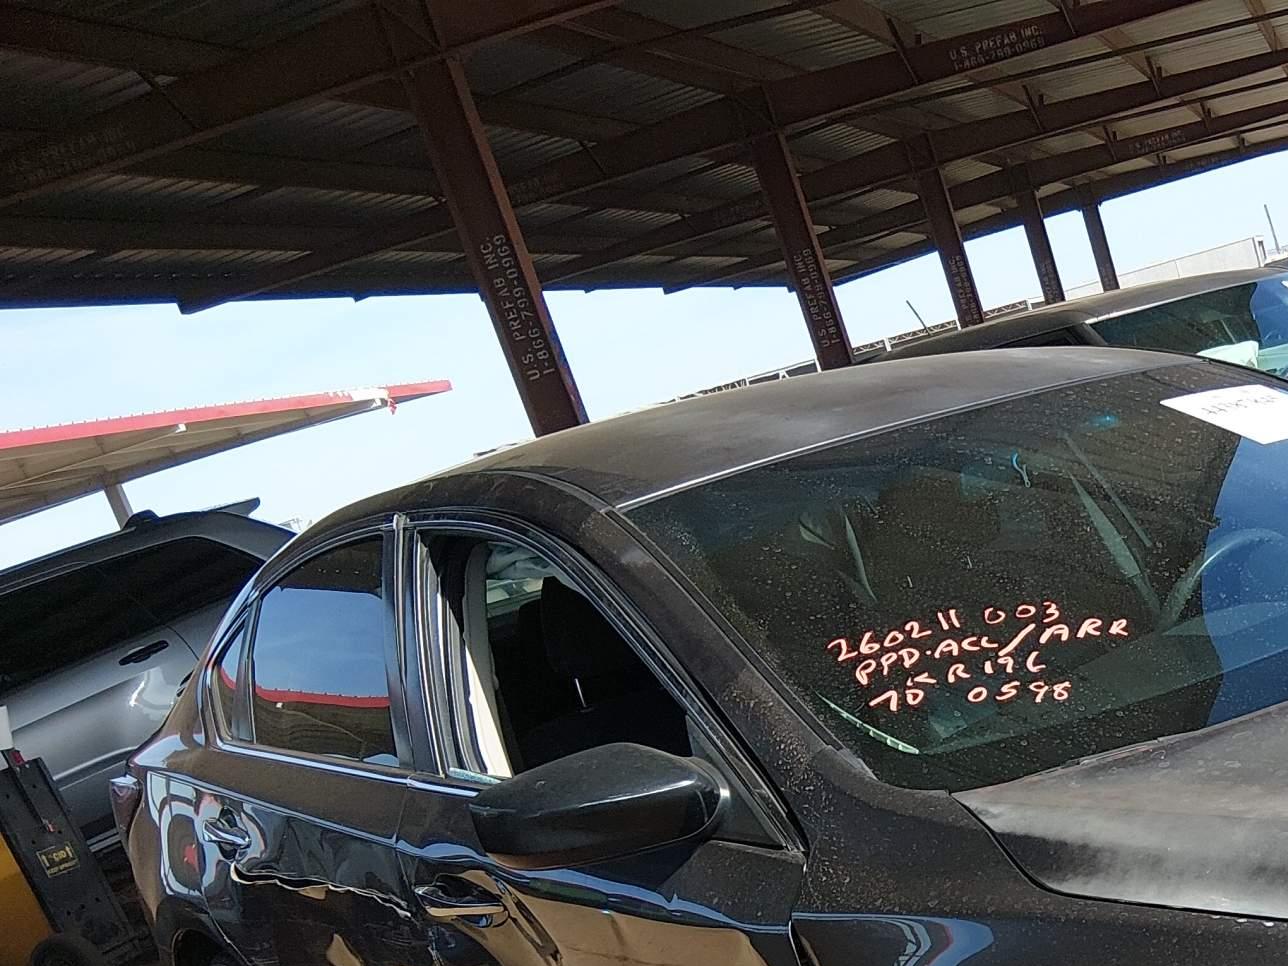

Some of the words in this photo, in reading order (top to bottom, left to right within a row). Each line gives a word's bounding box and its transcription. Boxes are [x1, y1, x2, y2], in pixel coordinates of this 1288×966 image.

[975, 31, 1018, 52] PREFAB
[480, 236, 499, 270] INC.
[493, 278, 527, 341] PREFAB
[521, 348, 541, 381] U.S.
